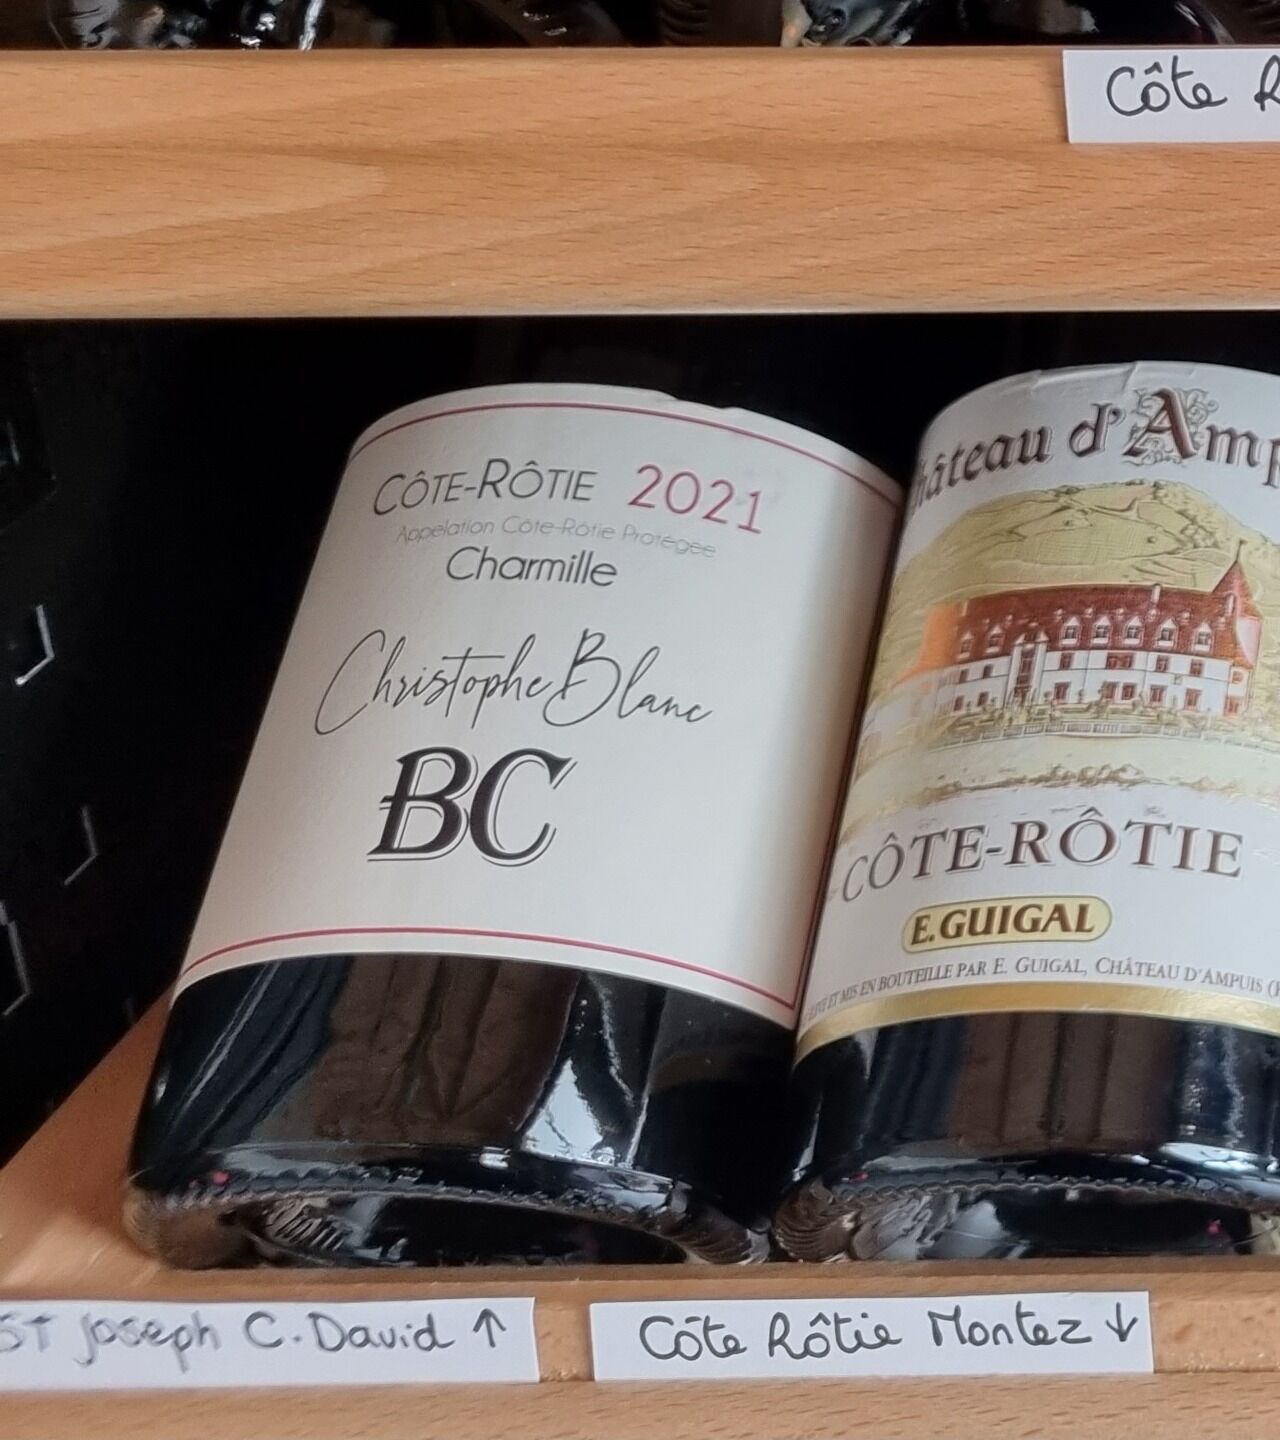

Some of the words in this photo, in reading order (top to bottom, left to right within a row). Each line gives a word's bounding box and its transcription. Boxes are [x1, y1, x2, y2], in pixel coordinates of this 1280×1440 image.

[1105, 54, 1228, 117] Côte
[373, 458, 598, 517] CÔTE-RÔTIE
[627, 463, 763, 535] 2021
[445, 545, 619, 587] Charmille
[313, 629, 552, 736] Christophe
[541, 627, 713, 728] Blanc
[366, 745, 579, 868] BC
[841, 805, 1245, 904] CÔTE-RÔTIE
[860, 979, 877, 998] EN
[878, 962, 954, 993] BOUTEILLE
[956, 960, 987, 978] PAR
[993, 957, 1009, 976] E.
[1095, 955, 1182, 981] CHÂTEAU
[638, 1313, 747, 1362] Côte
[767, 1310, 903, 1360] Rôtie
[927, 1301, 1093, 1348] Montez
